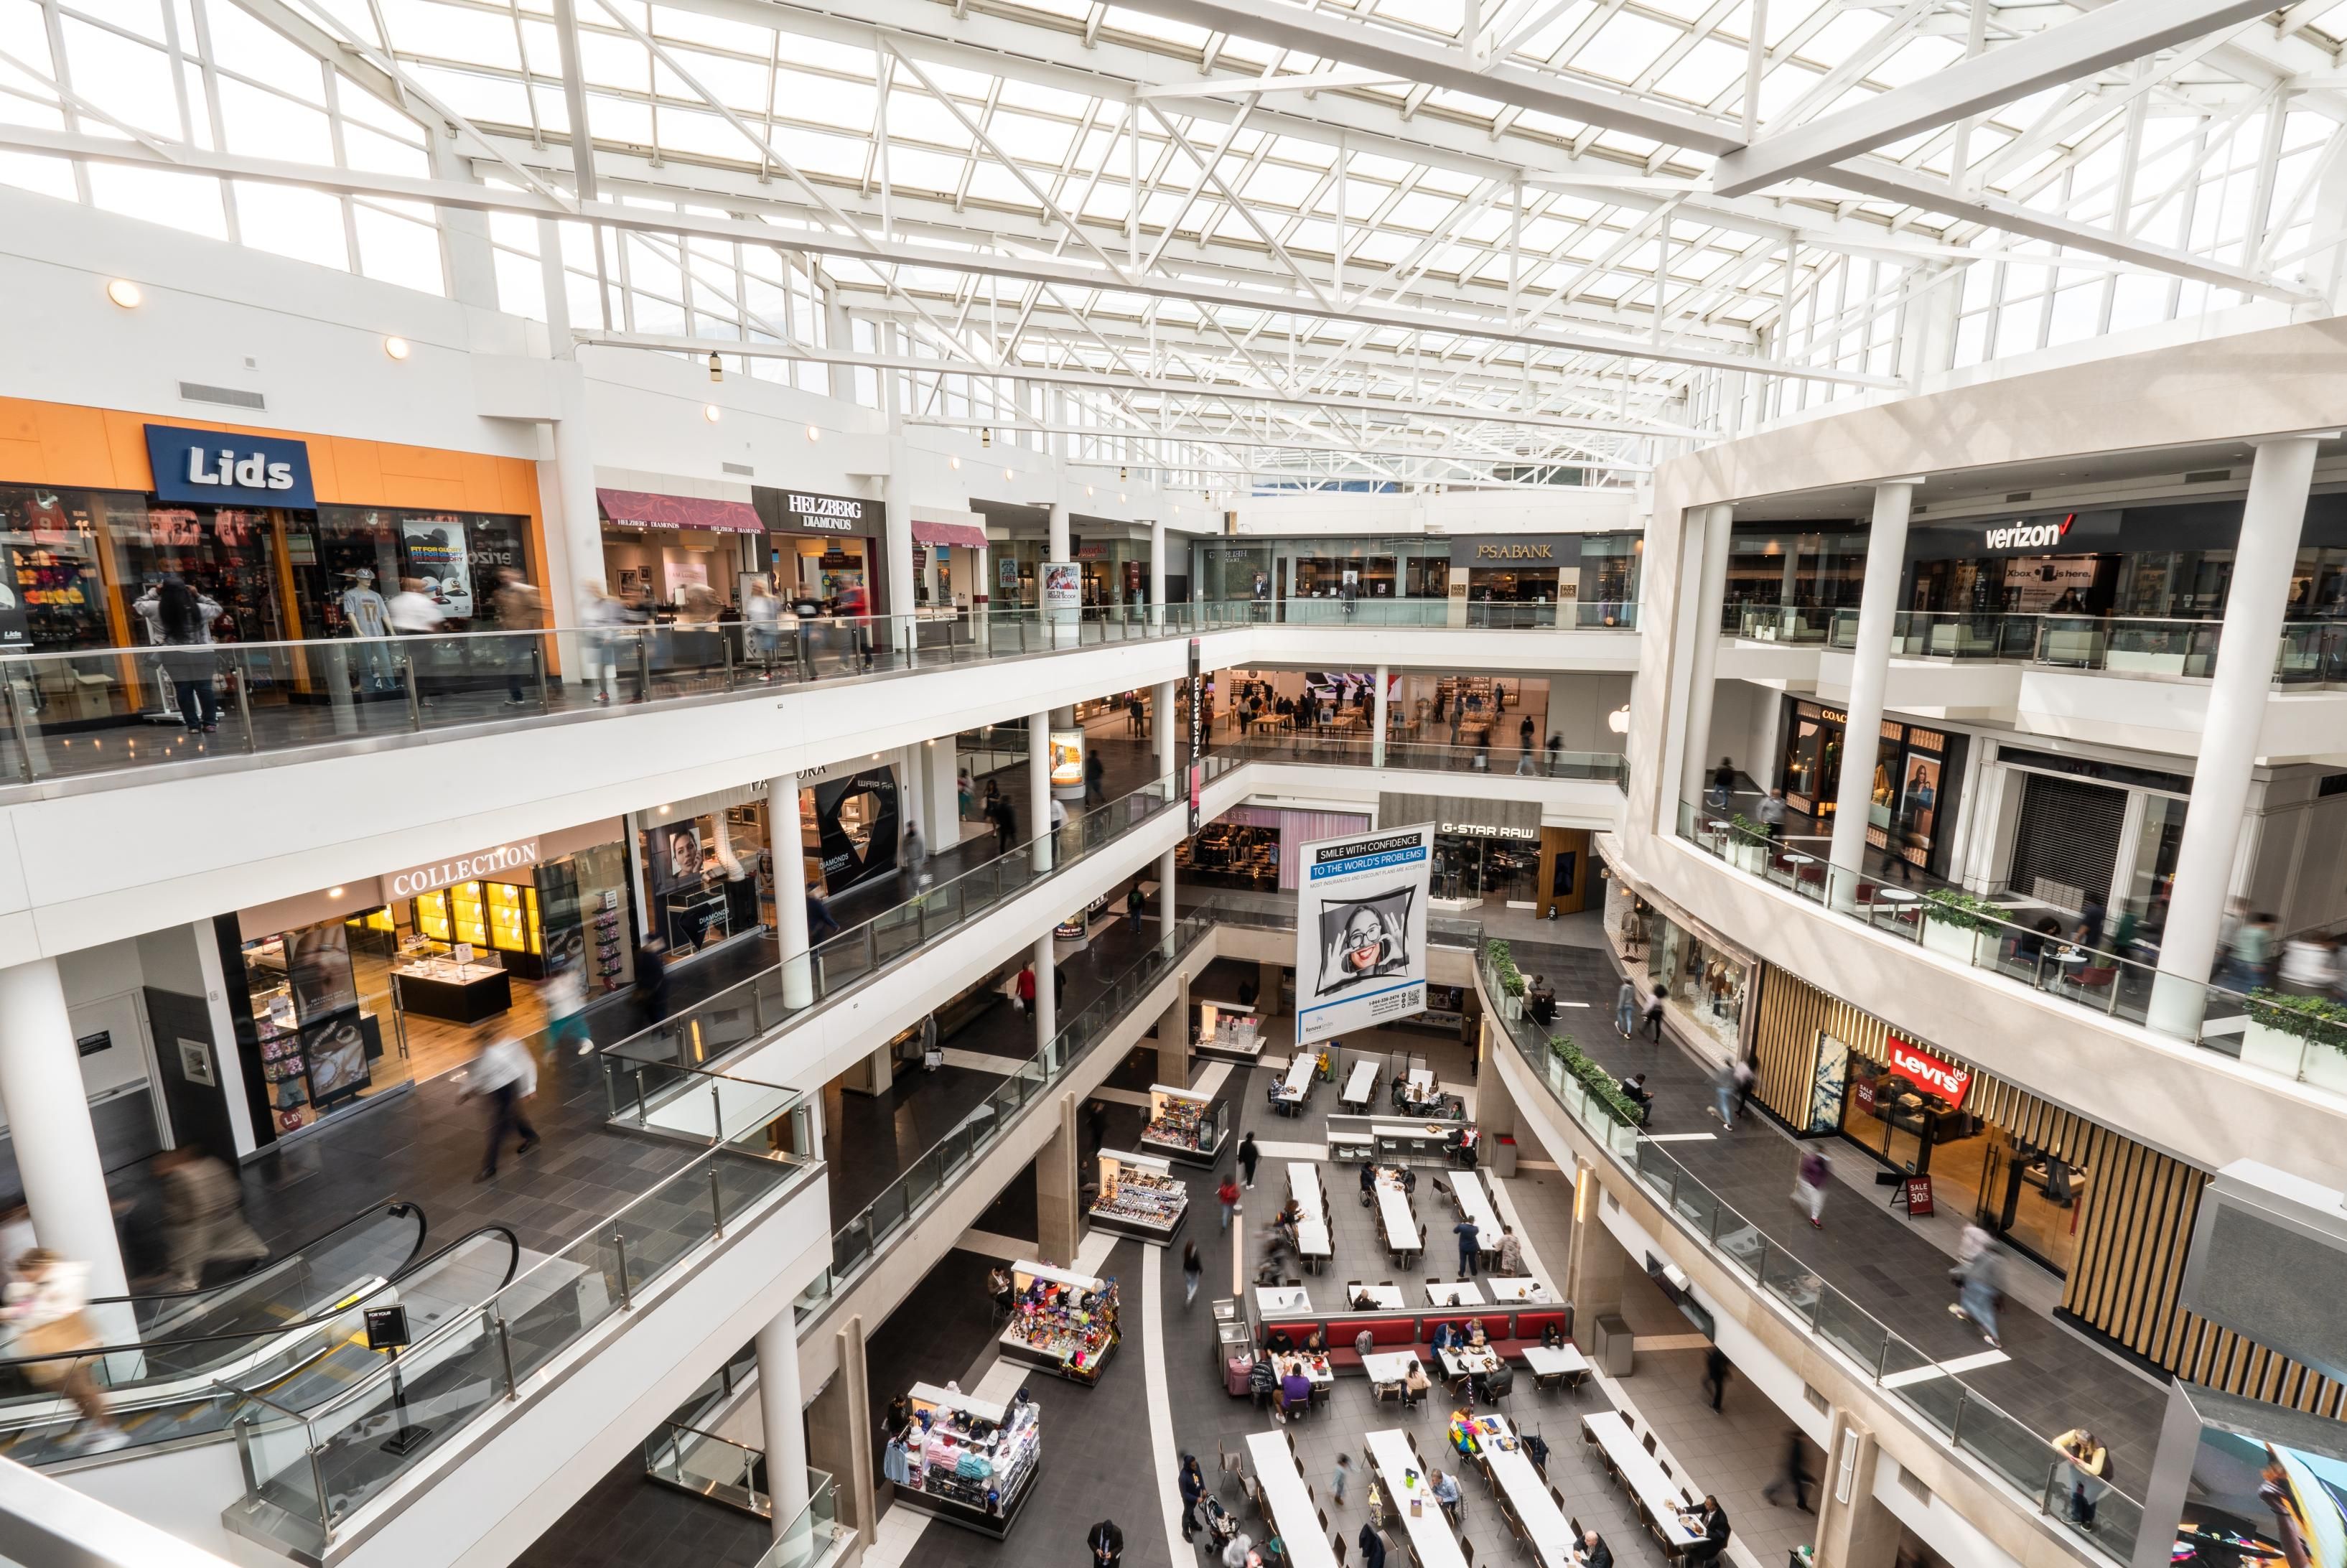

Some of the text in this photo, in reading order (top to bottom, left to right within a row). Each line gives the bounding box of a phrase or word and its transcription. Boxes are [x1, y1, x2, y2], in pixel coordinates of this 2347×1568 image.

[189, 446, 294, 490] Lids
[788, 494, 862, 518] HELZBERG
[803, 515, 851, 530] DIAMONDS
[1986, 521, 2060, 549] verizon
[1822, 709, 1847, 724] COAC
[1442, 823, 1534, 839] G-STAR RAW
[1320, 835, 1418, 859] SMILE WITH CONFIDENCE
[393, 843, 536, 896] COLLECTION
[820, 853, 849, 870] DIAMONDS
[826, 862, 845, 872] PANDORA
[1313, 849, 1423, 876] TO THE WORLD'S PROBLEMS!
[1323, 877, 1350, 887] INSURANCES
[1361, 871, 1381, 879] DISCOUNT
[699, 907, 729, 925] DIAMONDS
[1858, 1090, 1872, 1101] 30%
[1860, 1084, 1873, 1096] SALE
[1910, 1183, 1928, 1192] SALE
[1911, 1192, 1929, 1203] 30%
